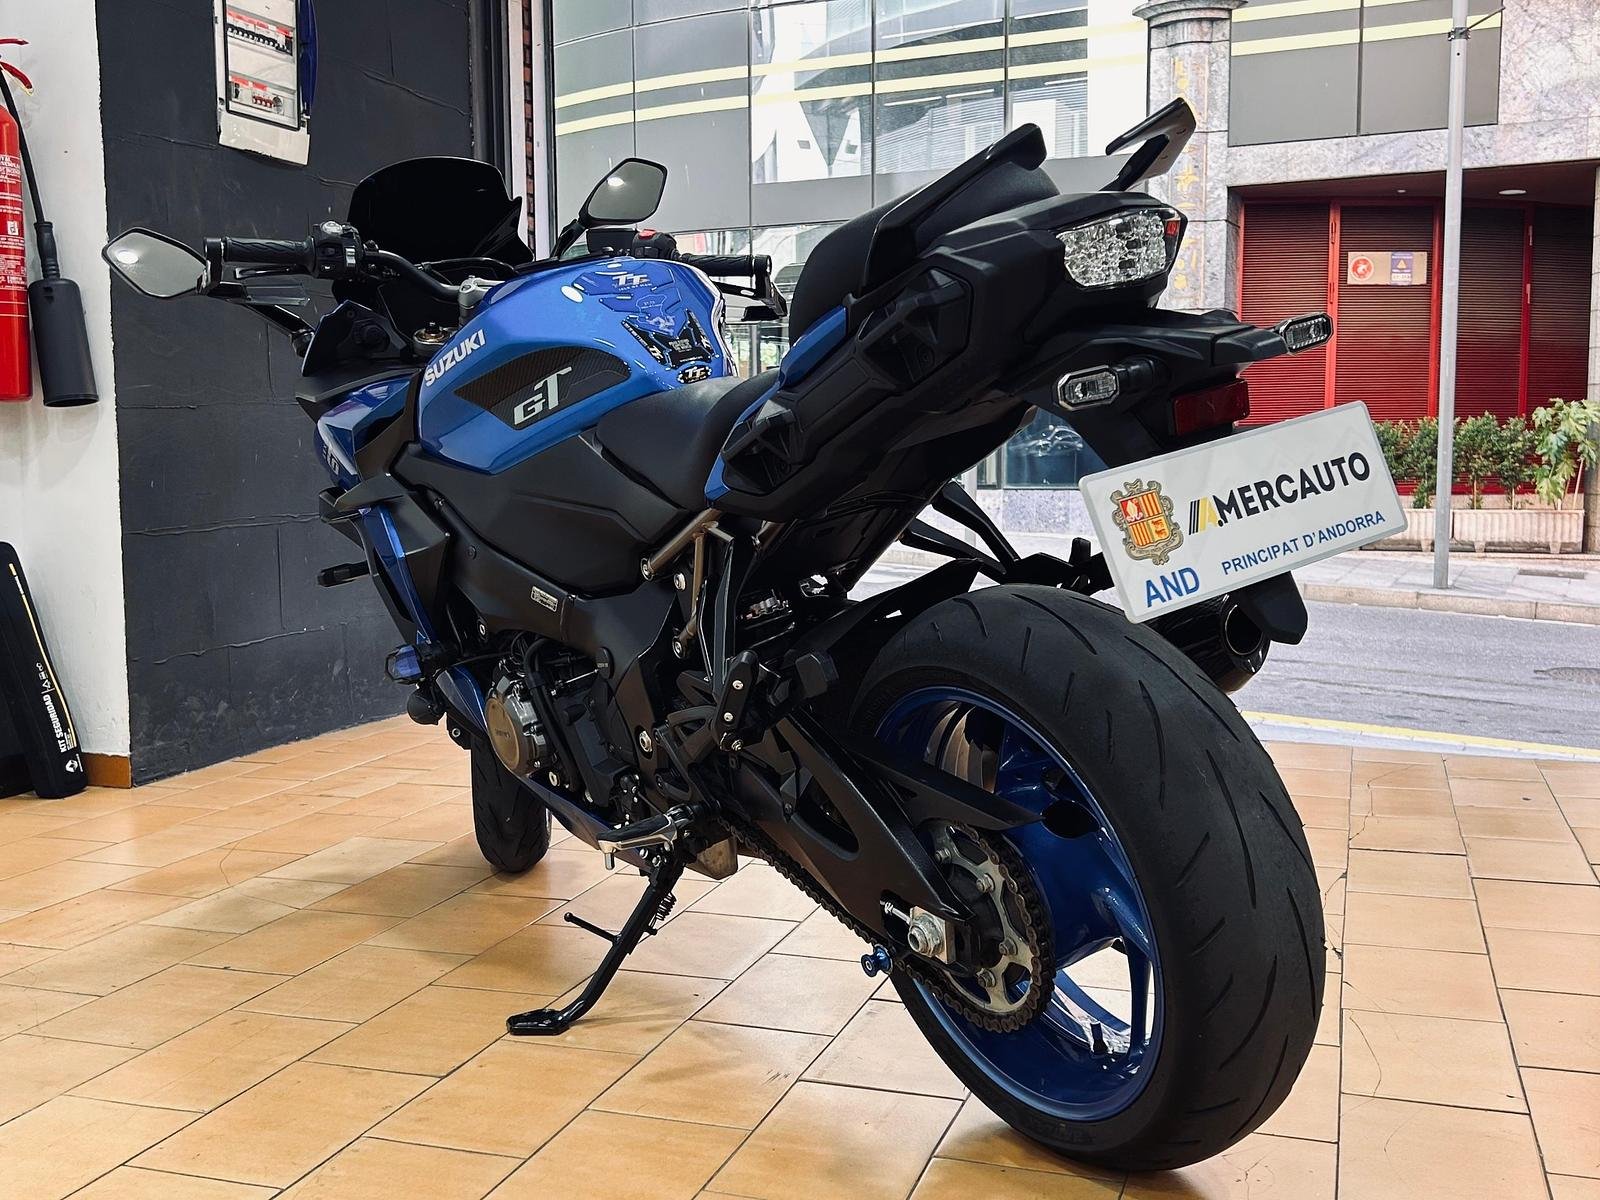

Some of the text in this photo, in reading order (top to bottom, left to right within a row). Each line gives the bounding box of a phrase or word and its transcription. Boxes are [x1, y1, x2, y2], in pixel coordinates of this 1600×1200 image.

[424, 329, 485, 387] SUZUKI
[514, 366, 572, 425] GT
[1221, 510, 1386, 576] PRINCIPAT D'ANDORRA
[1145, 567, 1200, 608] AND
[43, 694, 67, 753] KIT SEGURIDAD
